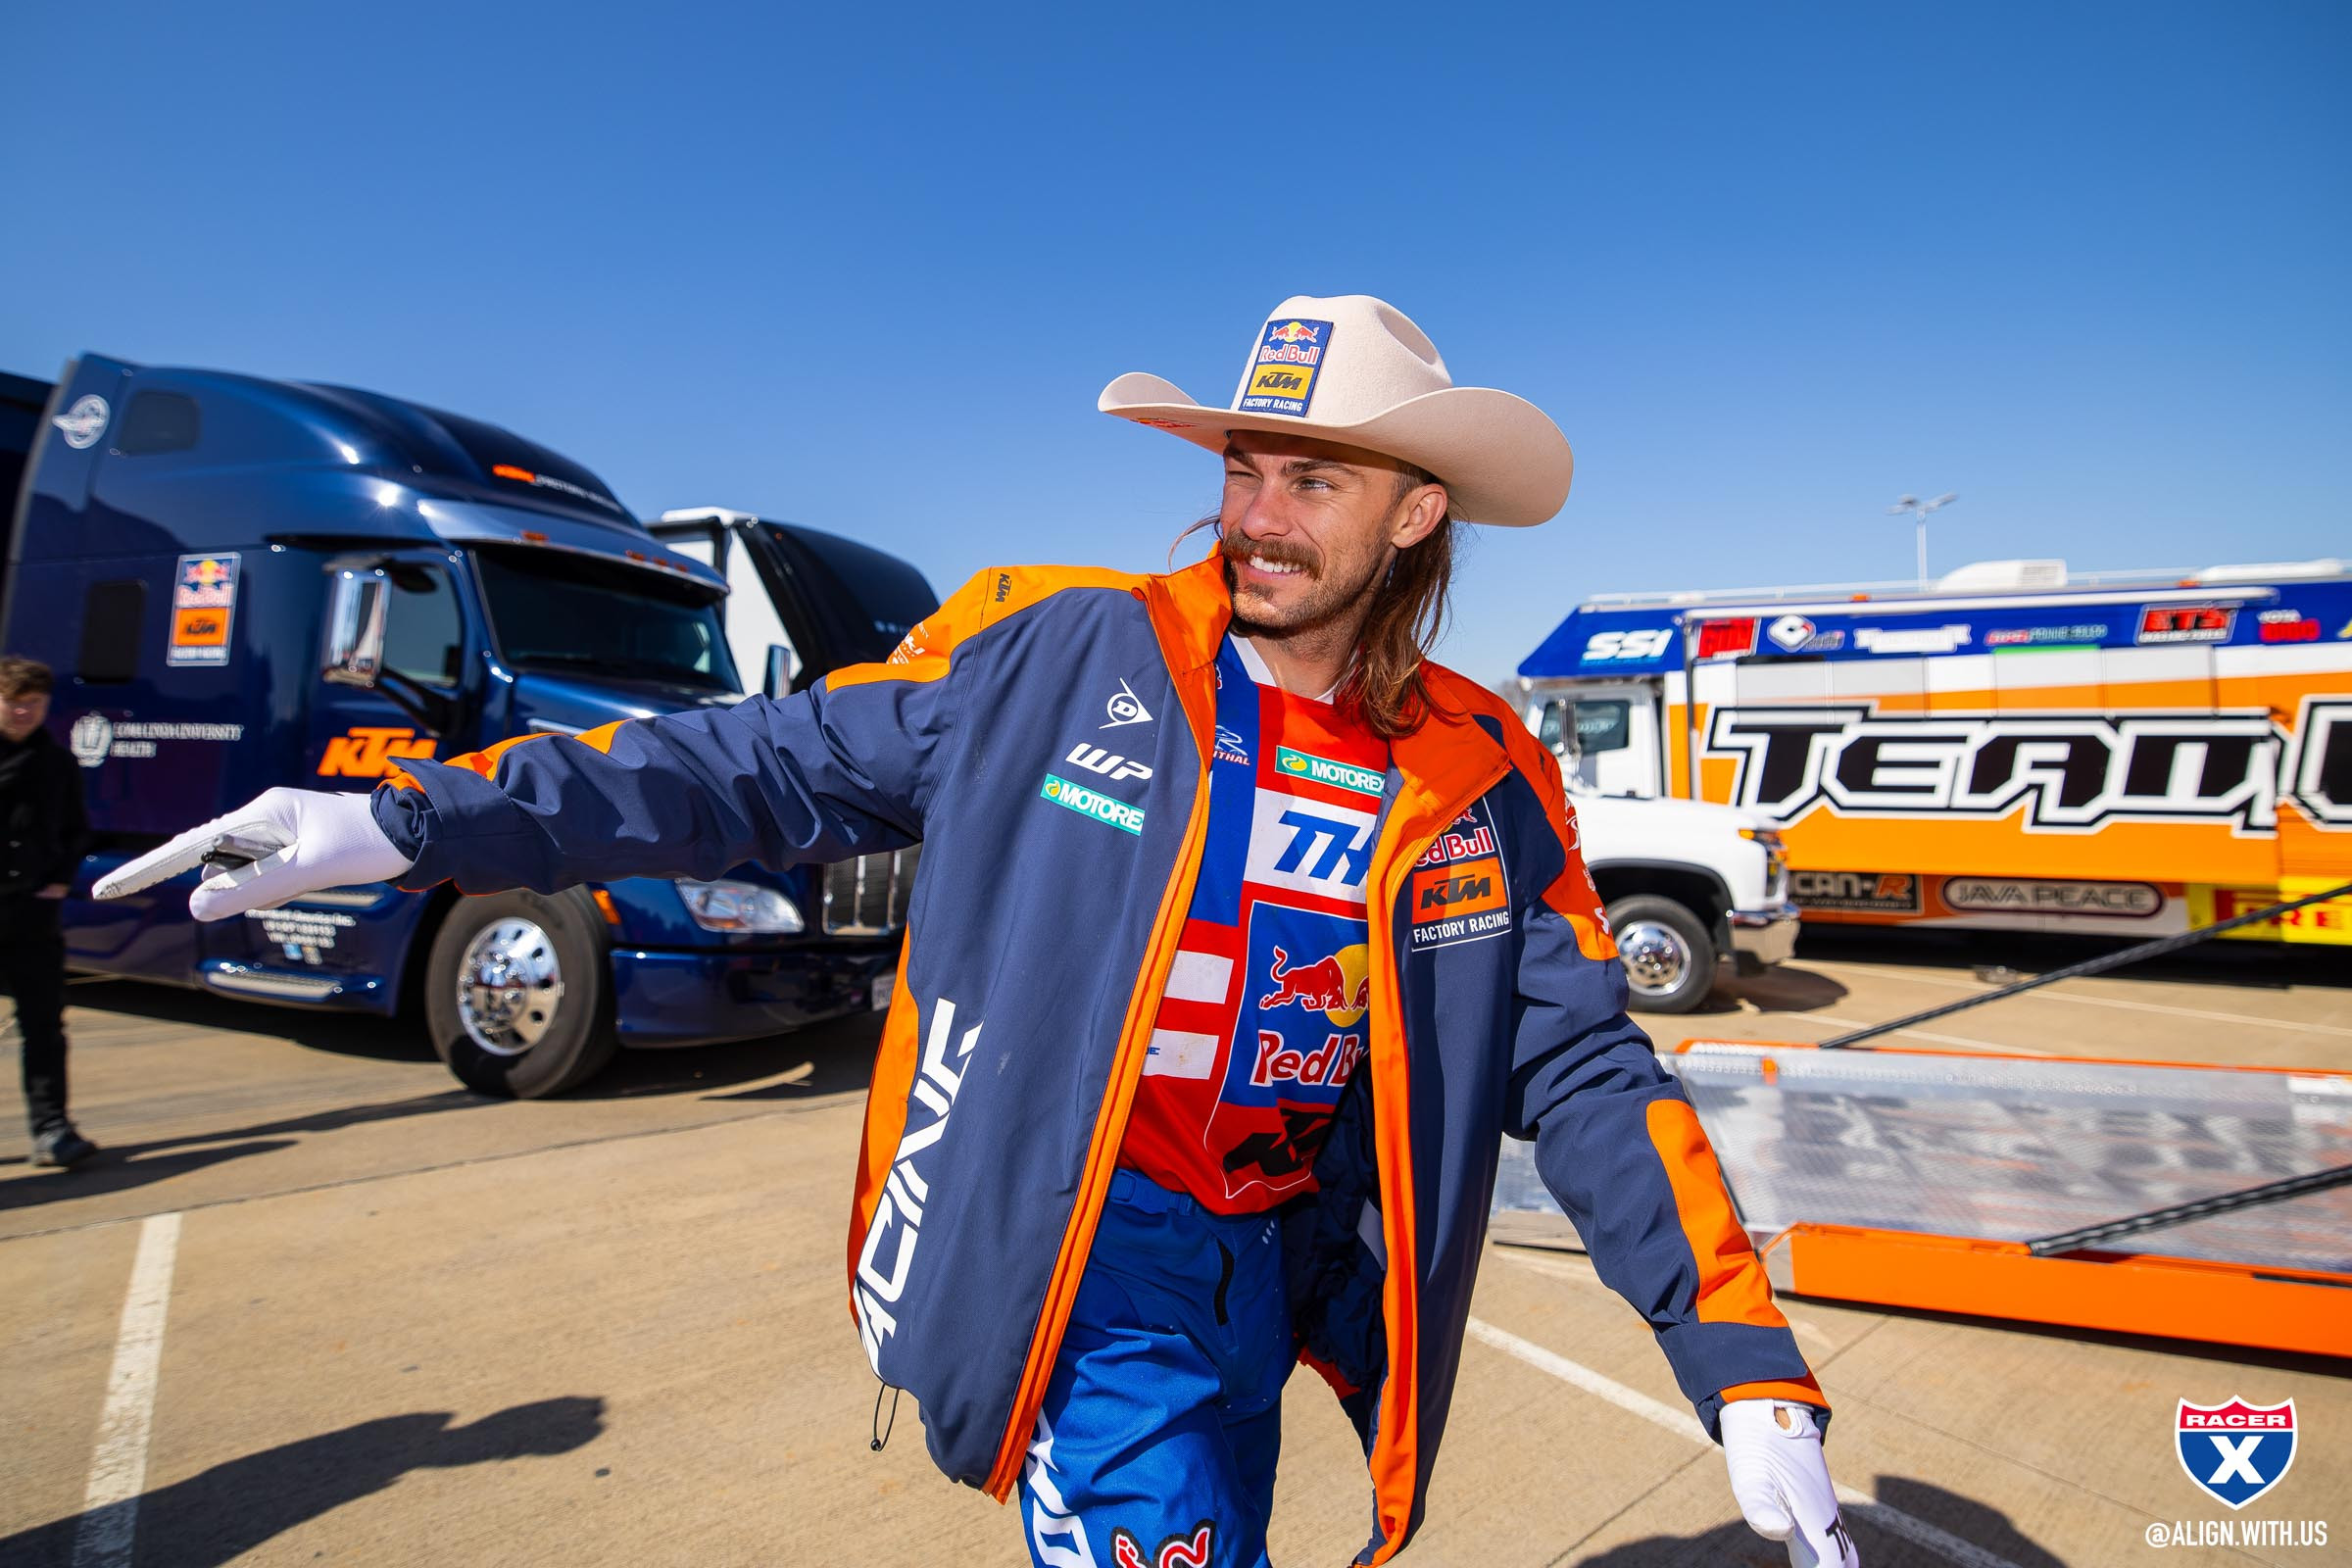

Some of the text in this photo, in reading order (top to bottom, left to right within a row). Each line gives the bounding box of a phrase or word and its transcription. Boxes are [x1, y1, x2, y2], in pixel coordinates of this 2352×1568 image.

[1258, 345, 1320, 365] Red Bull
[1256, 371, 1302, 390] KTM
[1243, 397, 1303, 412] FACTORY RACING
[995, 572, 1012, 603] KTM
[1582, 630, 1674, 661] SSI
[1065, 743, 1153, 780] WP
[1058, 783, 1145, 832] MOTORE
[1445, 826, 1495, 859] Bull
[1420, 874, 1491, 909] KTM
[1413, 910, 1510, 943] FACTORY RACING
[1250, 1029, 1340, 1087] Red
